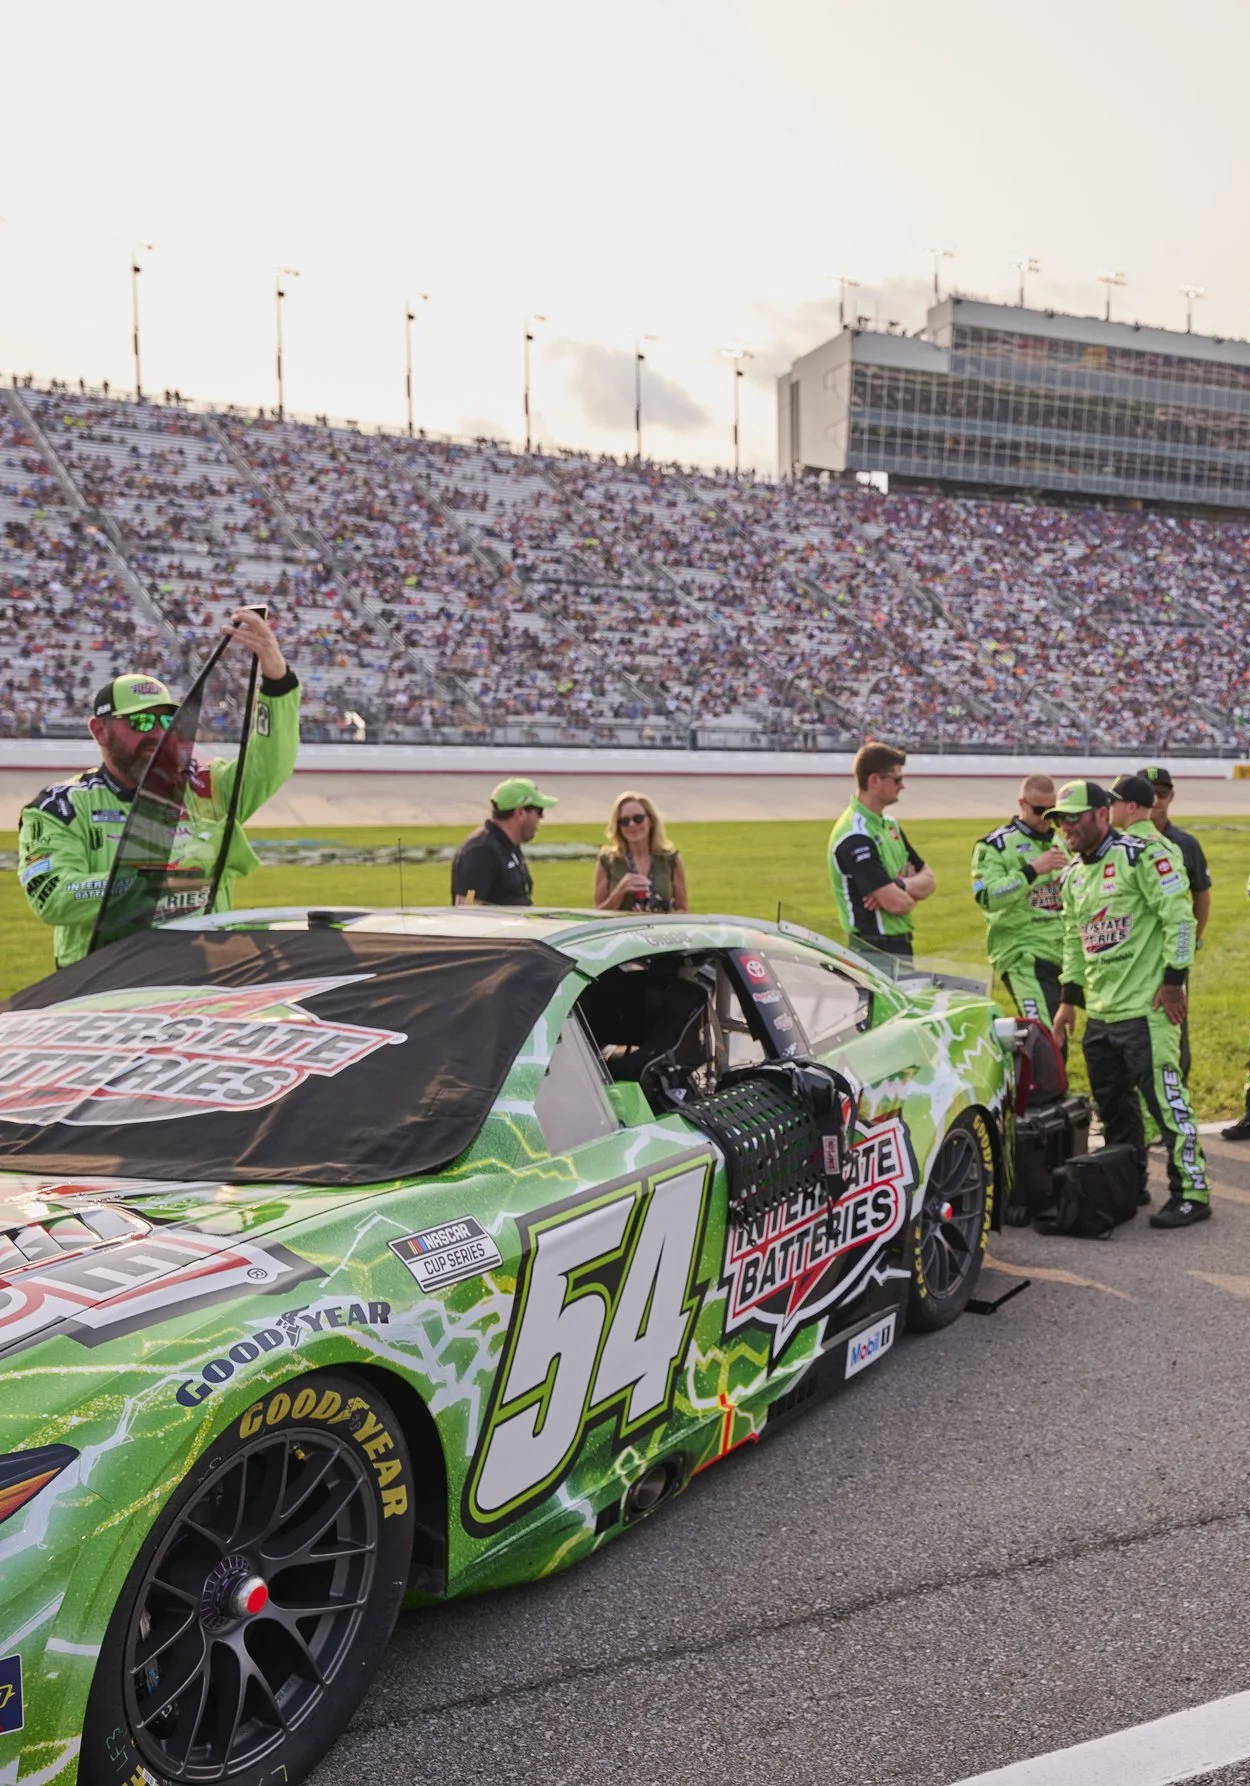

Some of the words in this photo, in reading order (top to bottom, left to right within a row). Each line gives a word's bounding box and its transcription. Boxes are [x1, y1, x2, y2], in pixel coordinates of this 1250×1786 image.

[0, 1014, 371, 1067] NTERSTATE
[421, 1222, 472, 1250] NASCAR
[423, 1258, 447, 1275] CUP
[446, 1243, 486, 1268] SERIES
[739, 1189, 892, 1306] BATTERIES
[175, 1301, 392, 1408] GOODYEAR
[476, 1165, 708, 1511] 54
[850, 1331, 881, 1366] Mobil
[239, 1387, 409, 1520] GOODYEAR
